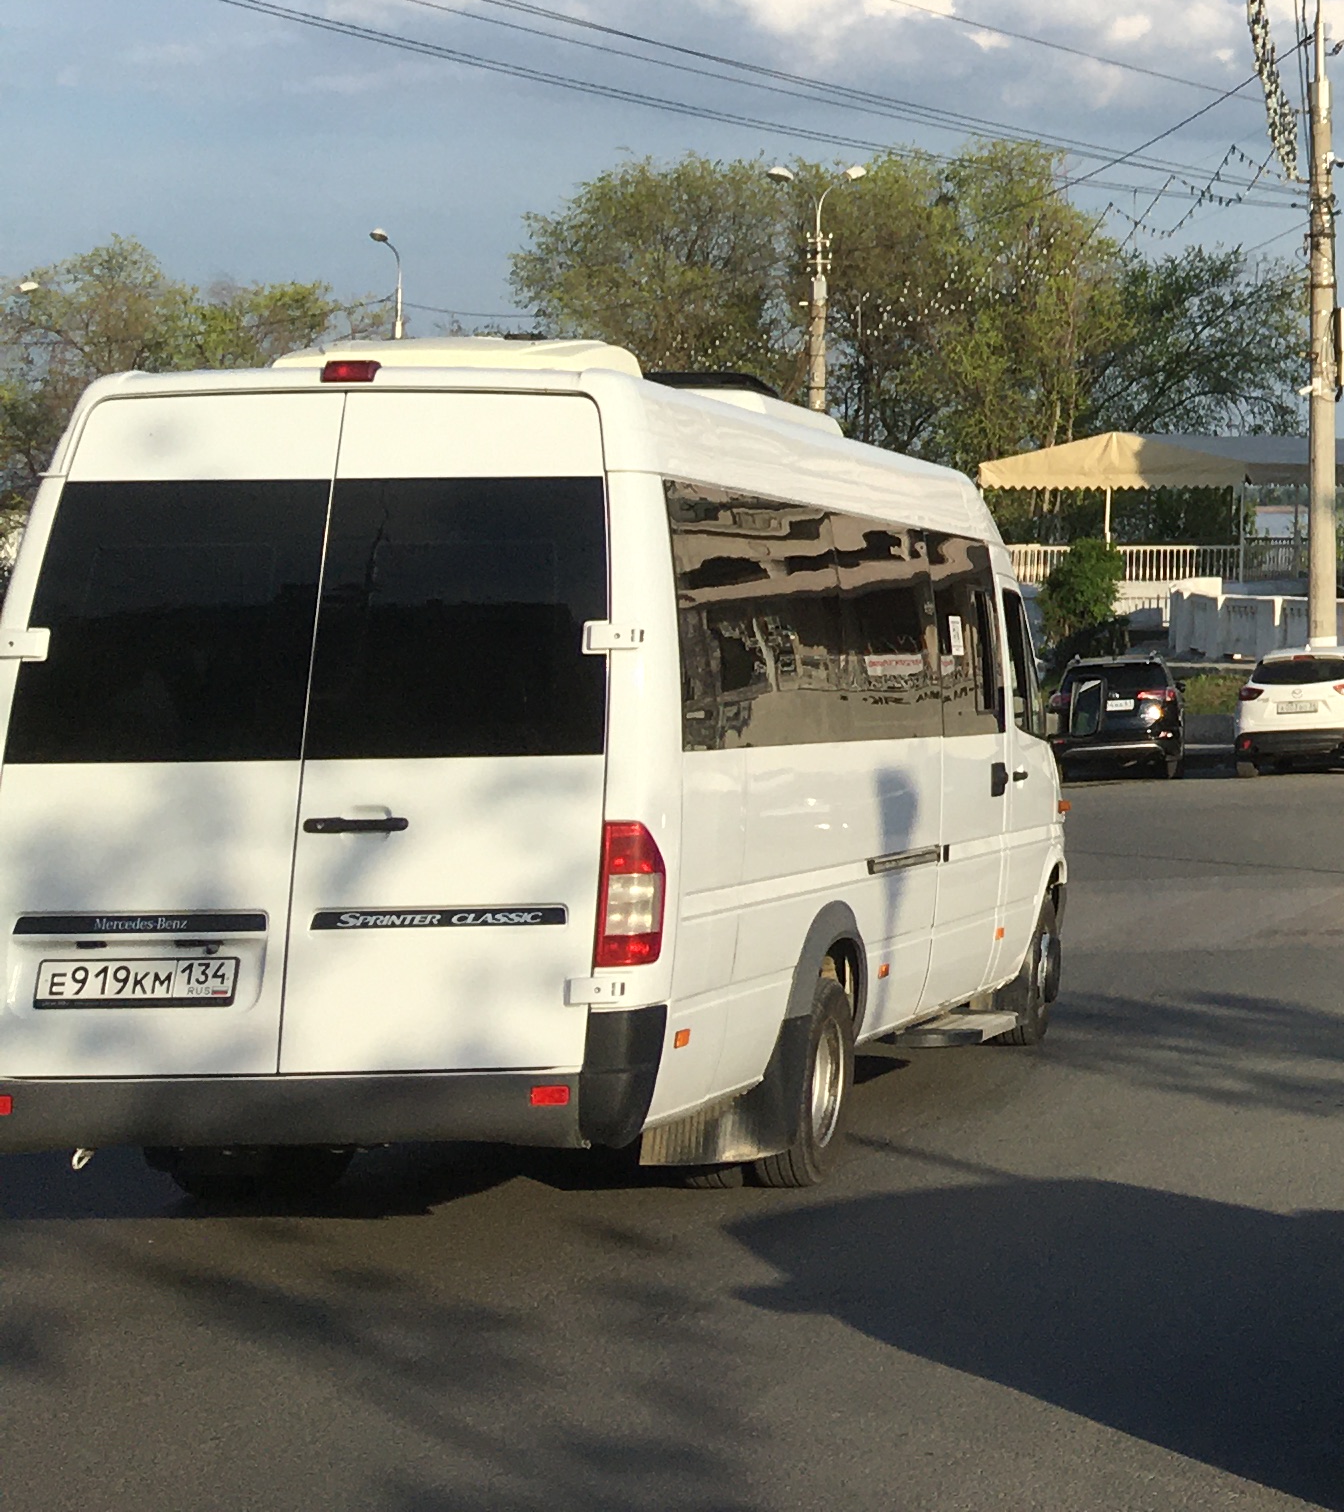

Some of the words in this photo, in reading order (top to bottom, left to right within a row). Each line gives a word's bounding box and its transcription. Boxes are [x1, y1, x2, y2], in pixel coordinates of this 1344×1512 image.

[94, 916, 188, 930] Mercedes-Benz
[337, 912, 441, 927] SPRINTER
[451, 911, 543, 924] CLASSIC
[48, 965, 173, 996] Е919КМ
[180, 961, 226, 986] 134
[186, 986, 212, 996] RUS
